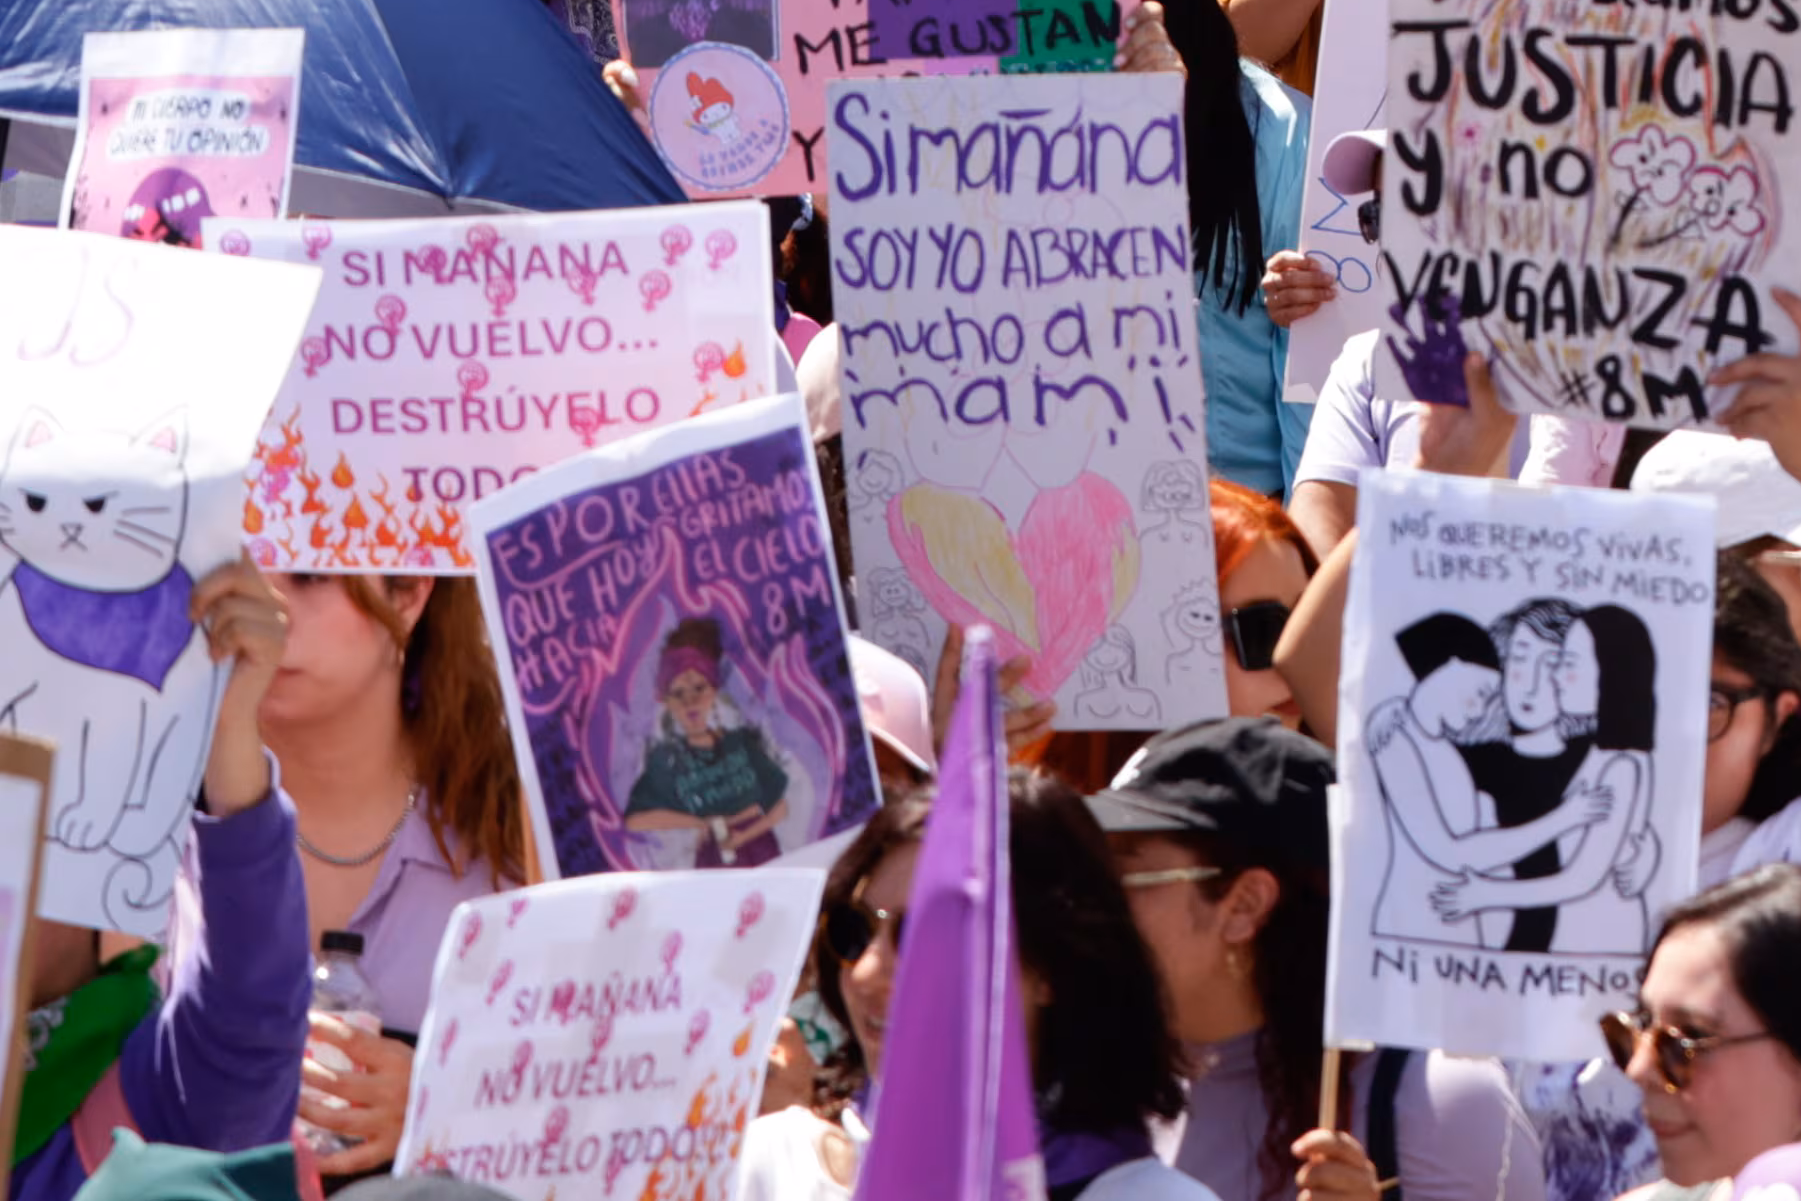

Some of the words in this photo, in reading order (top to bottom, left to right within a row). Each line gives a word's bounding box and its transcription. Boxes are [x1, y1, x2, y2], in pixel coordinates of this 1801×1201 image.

[794, 25, 886, 74] ME
[909, 0, 1121, 58] GUSTAN
[1392, 20, 1795, 134] JUSTICIA
[344, 251, 384, 286] SI
[405, 241, 629, 284] MAÑANA
[1001, 224, 1187, 289] ABRACEN
[325, 324, 394, 362] NO
[333, 387, 660, 436] DESTRÚYELO
[1520, 558, 1541, 582] Y
[1435, 955, 1501, 989] UNA
